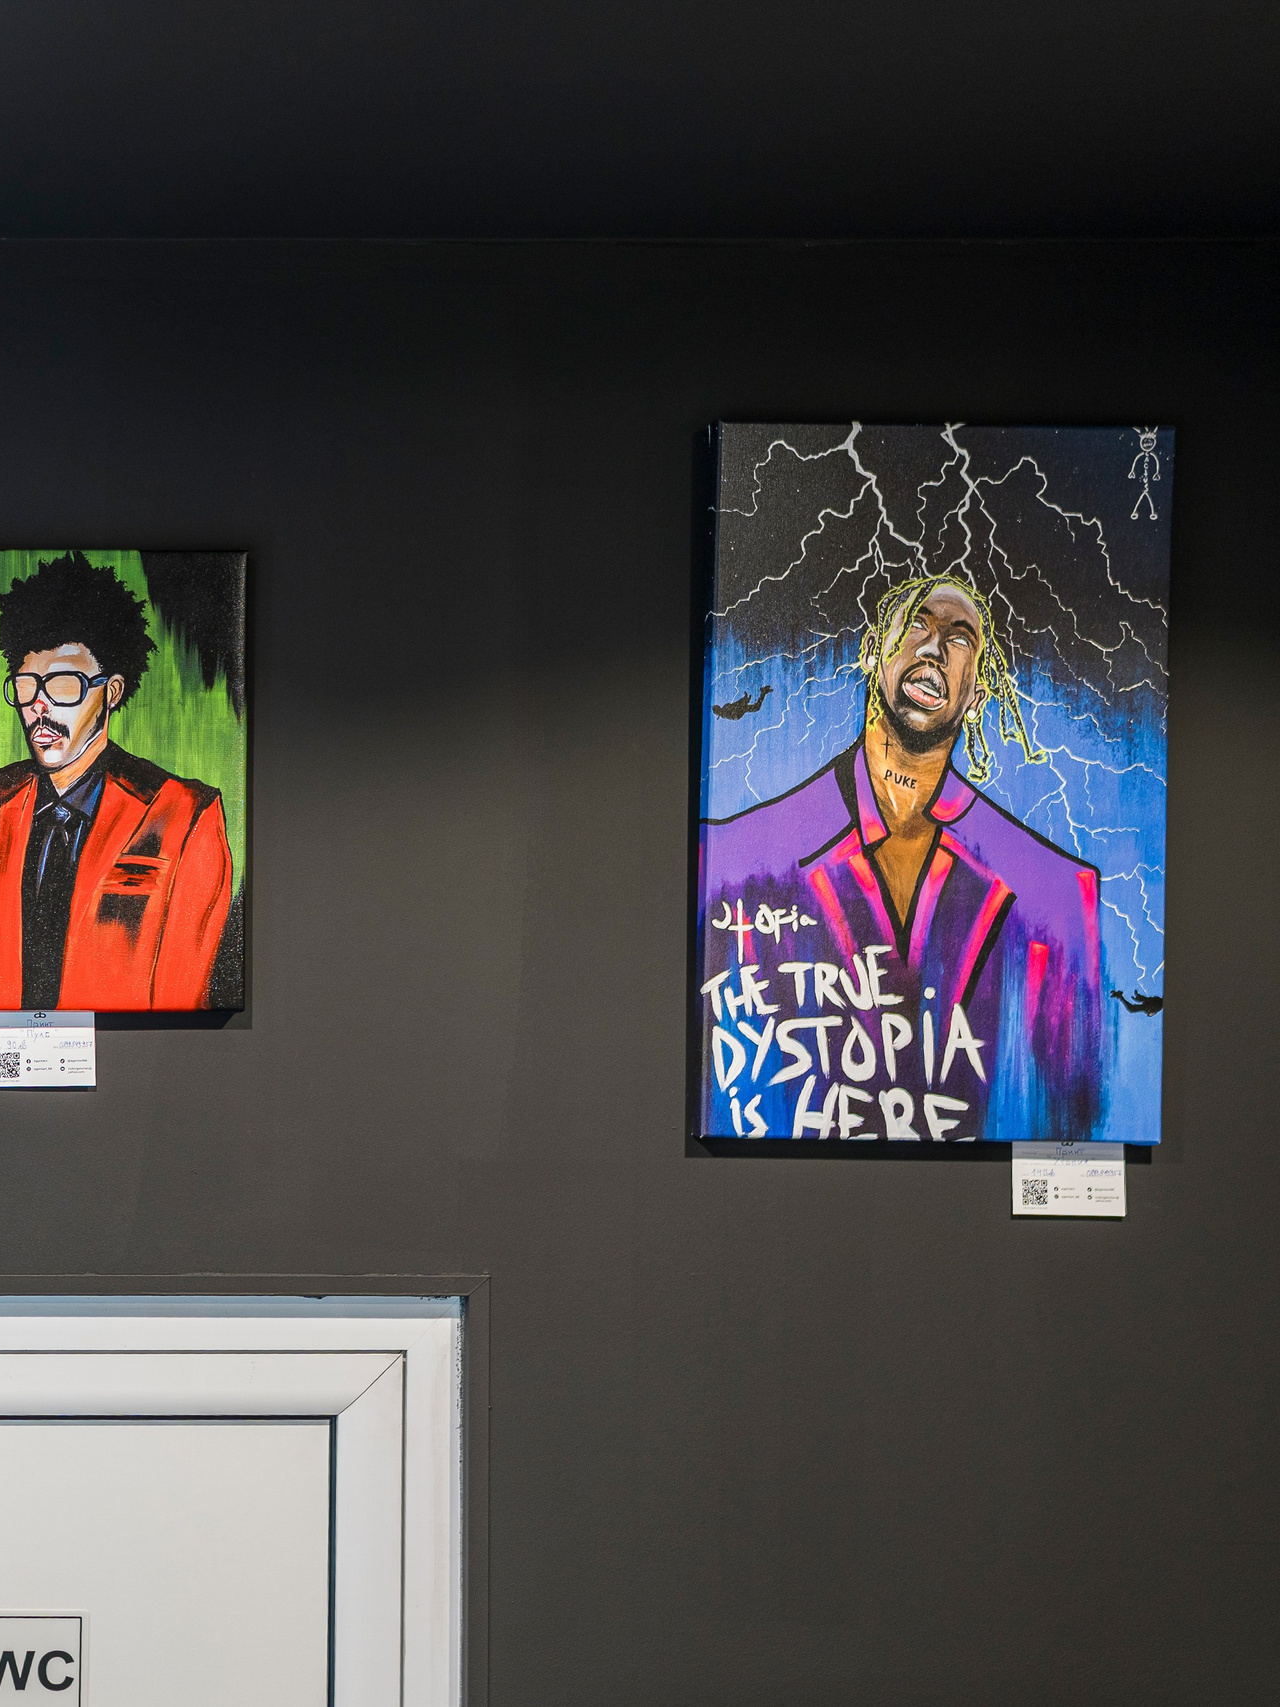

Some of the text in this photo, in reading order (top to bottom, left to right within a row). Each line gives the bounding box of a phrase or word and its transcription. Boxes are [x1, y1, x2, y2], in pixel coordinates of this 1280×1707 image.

[883, 769, 917, 789] PUKE
[700, 945, 905, 1022] THE TRUE
[792, 1075, 976, 1141] HERE
